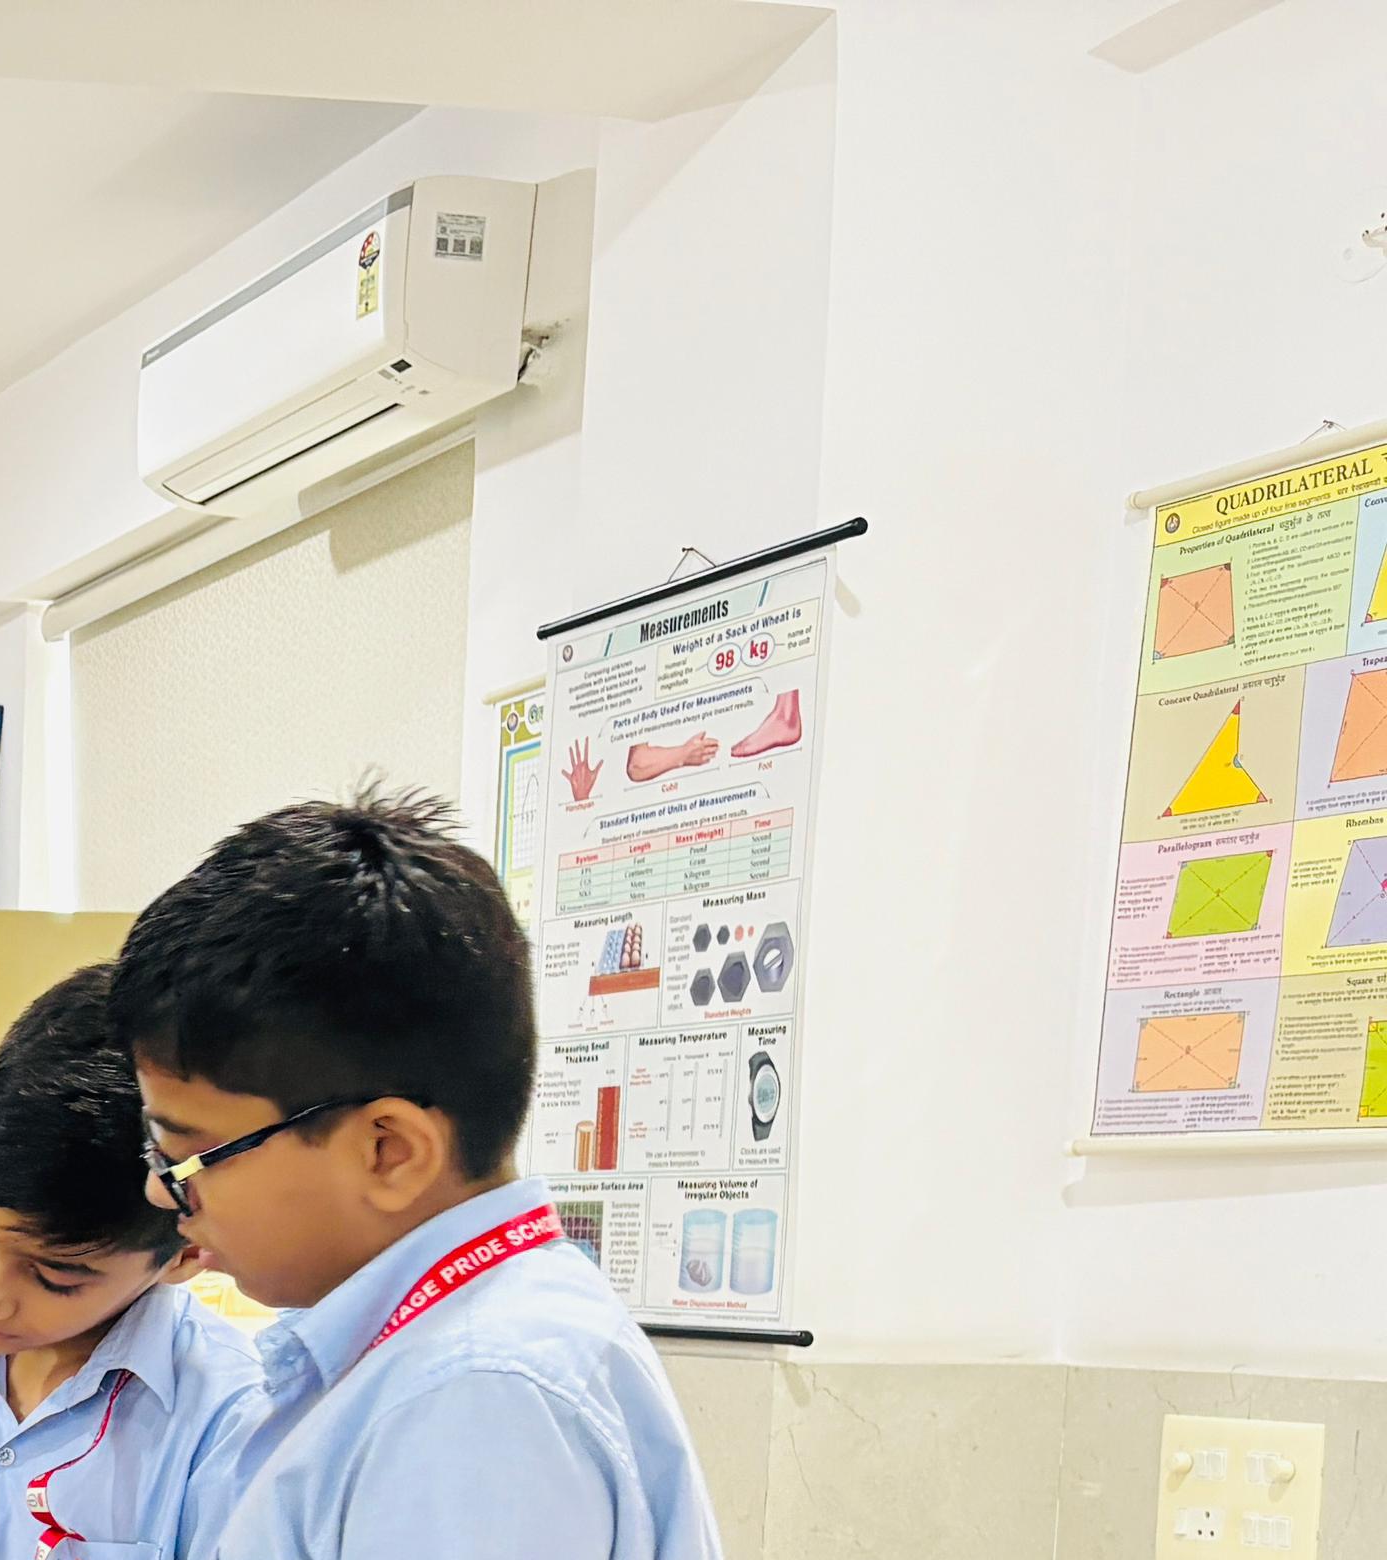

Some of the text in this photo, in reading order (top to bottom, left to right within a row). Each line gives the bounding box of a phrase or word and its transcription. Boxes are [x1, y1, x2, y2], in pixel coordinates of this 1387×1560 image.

[1216, 458, 1373, 514] QUADRILATERAL
[1192, 522, 1213, 534] Closed
[1215, 518, 1231, 531] figure
[1233, 513, 1250, 524] made
[1252, 511, 1260, 520] up
[1261, 507, 1269, 518] of
[1270, 504, 1283, 515] four
[1299, 493, 1331, 510] segments
[1179, 524, 1274, 555] Properties of Quadrilateral
[640, 600, 728, 643] Measurements
[673, 637, 702, 655] Weight
[706, 633, 714, 645] of
[726, 626, 746, 639] Sack
[750, 621, 759, 631] of
[762, 611, 789, 627] Wheat
[793, 608, 801, 617] is
[787, 630, 803, 639] name
[716, 640, 768, 671] 98 kg
[1158, 683, 1239, 707] Concave Quadrilateral
[613, 685, 752, 729] Parts of Body Used For Measurements
[599, 789, 756, 830] Standard System of Units of Measurements
[629, 841, 651, 853] Length
[676, 831, 693, 843] Mass
[695, 827, 724, 840] (Weight)
[754, 819, 771, 828] Time
[1158, 840, 1211, 854] Parallelogram
[703, 891, 766, 908] Measuring Mass
[574, 912, 633, 929] Measuring Length
[1347, 976, 1373, 986] Square
[1164, 989, 1199, 1000] Rectangle
[639, 1031, 727, 1046] Measuring Temperature
[748, 1025, 786, 1037] Measuring
[555, 1042, 589, 1054] Measuring
[758, 1037, 776, 1045] Time
[571, 1182, 643, 1193] Irregular Surface Area
[678, 1179, 757, 1191] Measuring Volume of
[685, 1191, 749, 1200] Irregular Objects
[439, 1238, 508, 1285] PRIDE
[505, 1212, 561, 1247] SCHO
